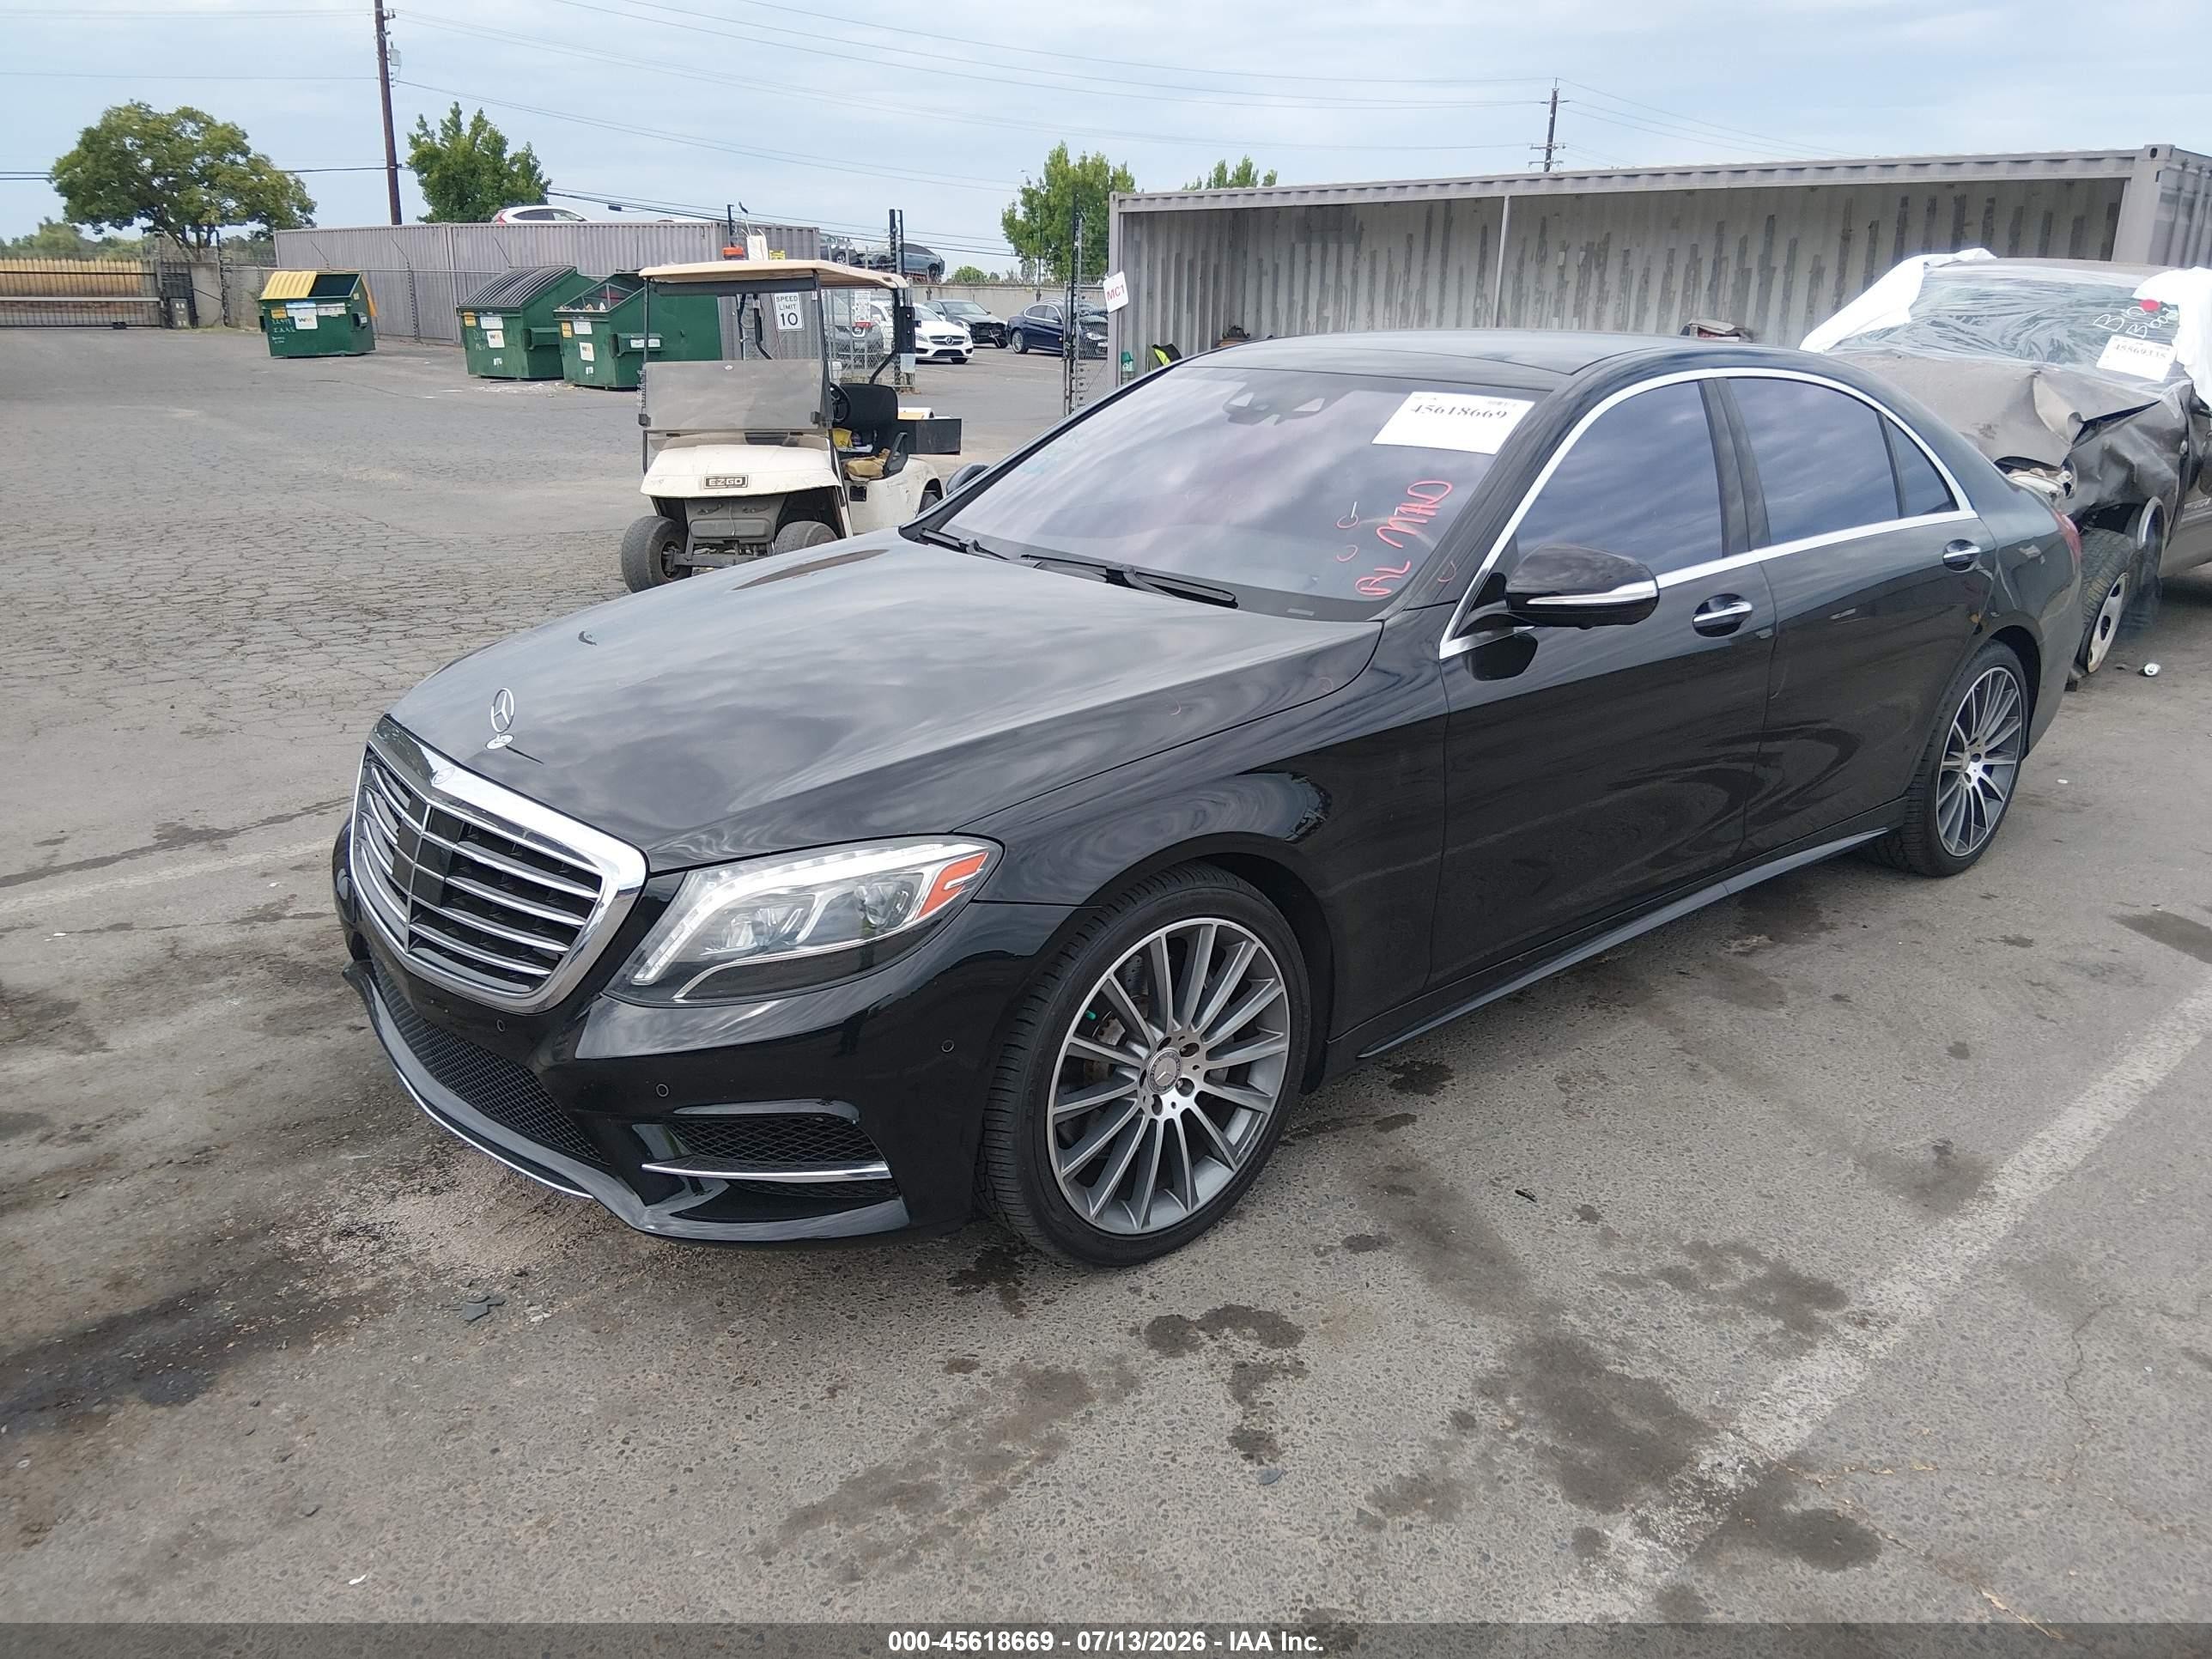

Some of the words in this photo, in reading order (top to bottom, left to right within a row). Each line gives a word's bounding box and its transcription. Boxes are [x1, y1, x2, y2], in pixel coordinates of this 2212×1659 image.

[1107, 284, 1125, 301] MC1
[781, 312, 799, 326] 10
[1411, 404, 1507, 419] 45618669
[708, 477, 743, 486] EZGO
